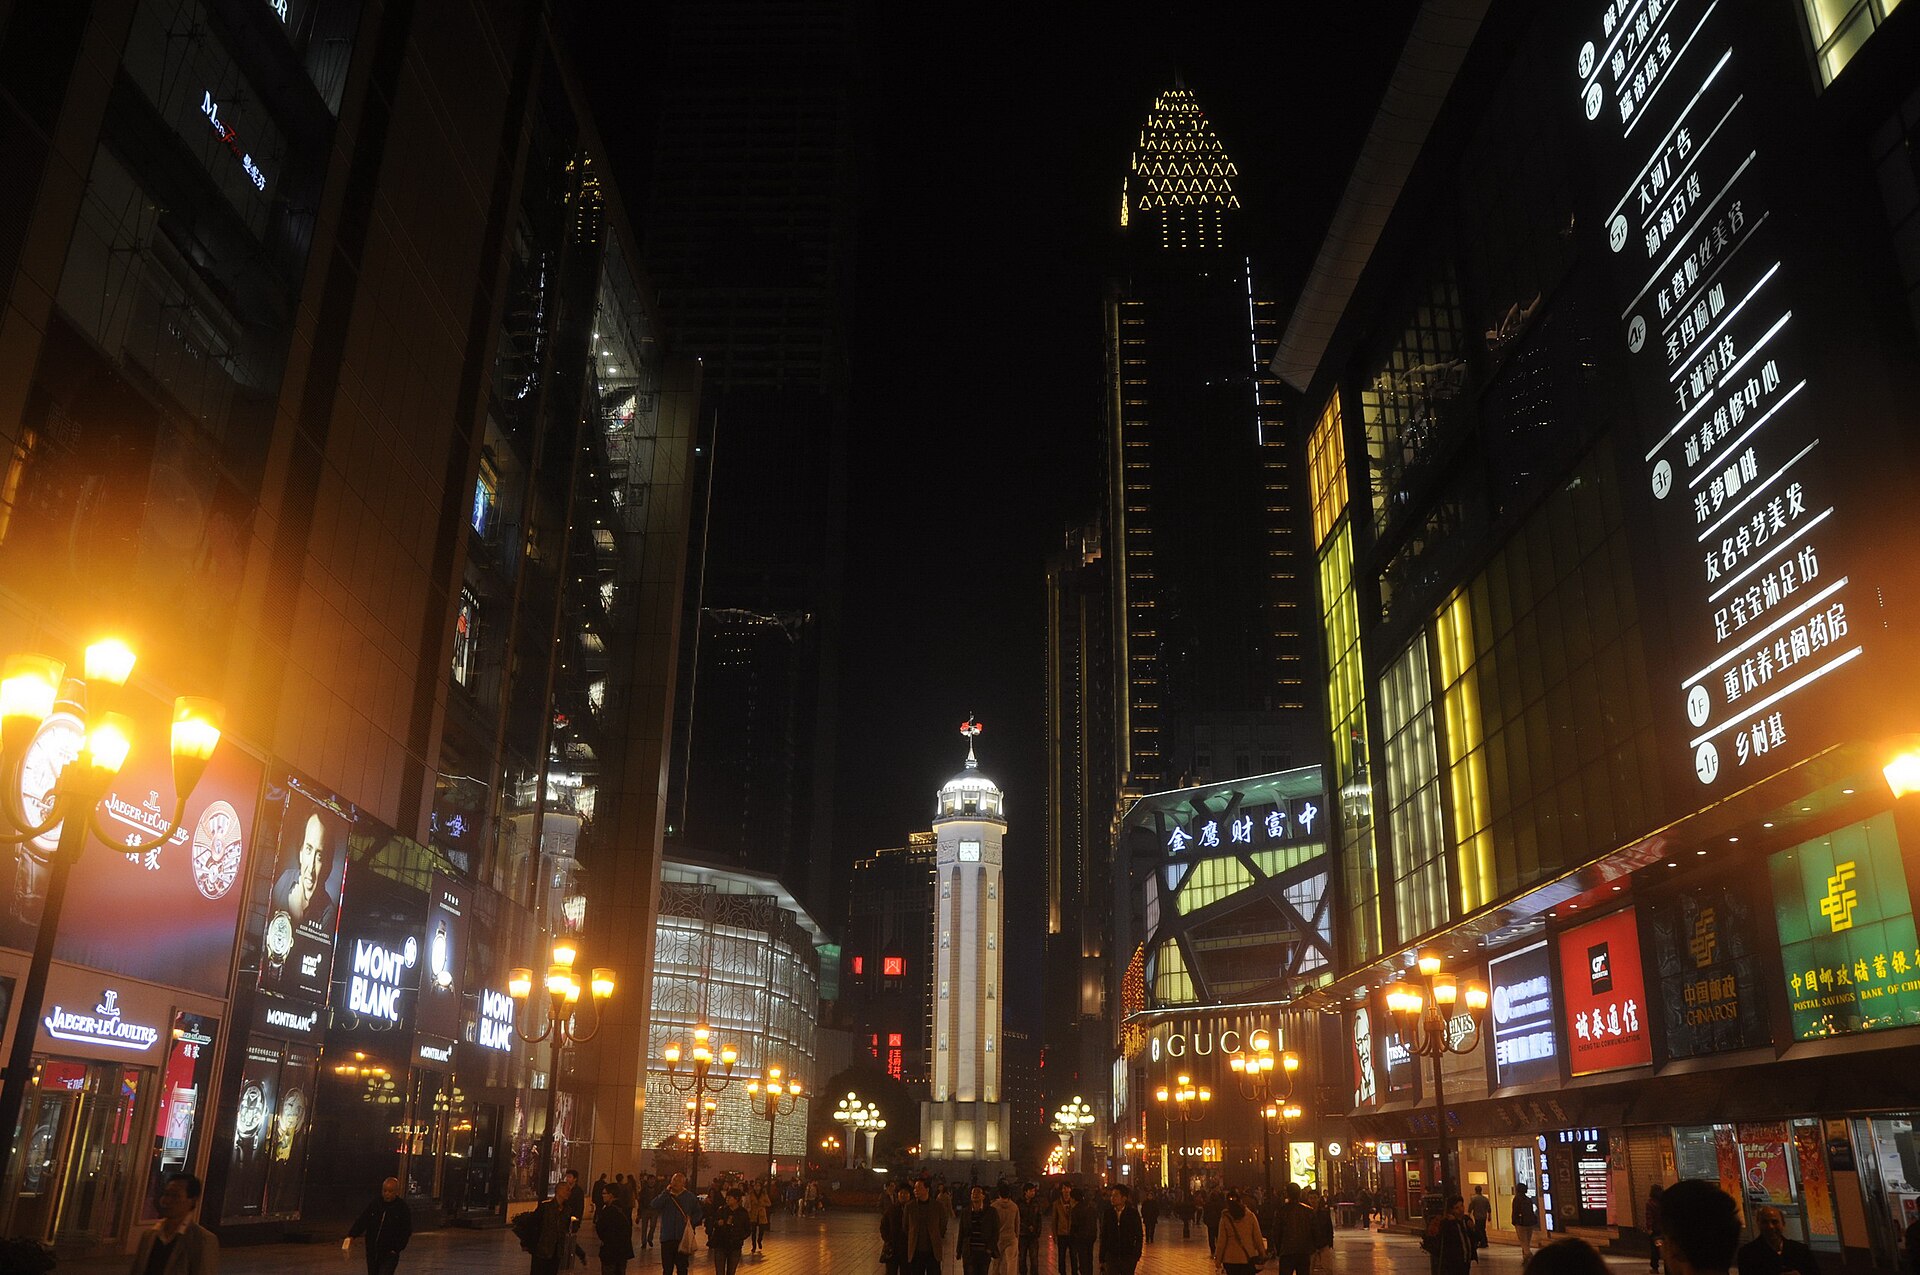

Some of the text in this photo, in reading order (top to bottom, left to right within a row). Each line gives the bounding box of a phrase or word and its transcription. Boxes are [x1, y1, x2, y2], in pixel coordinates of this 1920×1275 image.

[1619, 33, 1672, 123] 瑞帝珠宝
[1588, 89, 1601, 116] 6F
[1638, 127, 1692, 215] 大河广告
[1611, 221, 1627, 249] 5F
[1645, 171, 1702, 259] 渝商百货
[1657, 200, 1744, 319] 佐登妮丝美容
[1629, 324, 1645, 348] 4F
[1665, 282, 1726, 366] 圣玛瑜伽
[1684, 359, 1781, 468] 诚泰维修中心
[1652, 469, 1670, 496] 3F
[1694, 446, 1758, 524] 米萝咖啡
[1704, 481, 1806, 583] 友名卓艺美发
[1713, 544, 1819, 644] 足宝宝沐足坊
[1723, 602, 1848, 704] 重庆养生阁药房
[1690, 696, 1705, 718] 1F
[1735, 711, 1787, 767] 乡村基
[1167, 801, 1319, 852] 金鹰财富中
[354, 938, 405, 986] MONT
[349, 976, 401, 1022] BLANC
[482, 988, 514, 1023] MONT
[1684, 975, 1737, 1008] 中国邮政
[1793, 998, 1821, 1012] POSTAL
[1821, 992, 1856, 1007] SAVINGS
[1861, 986, 1884, 1000] BANK
[1887, 983, 1899, 995] OF
[266, 1008, 312, 1032] MONTBLANC
[479, 1020, 513, 1052] BLANC
[1167, 1028, 1284, 1057] GUCCI
[420, 1045, 450, 1062] MONTBLANC
